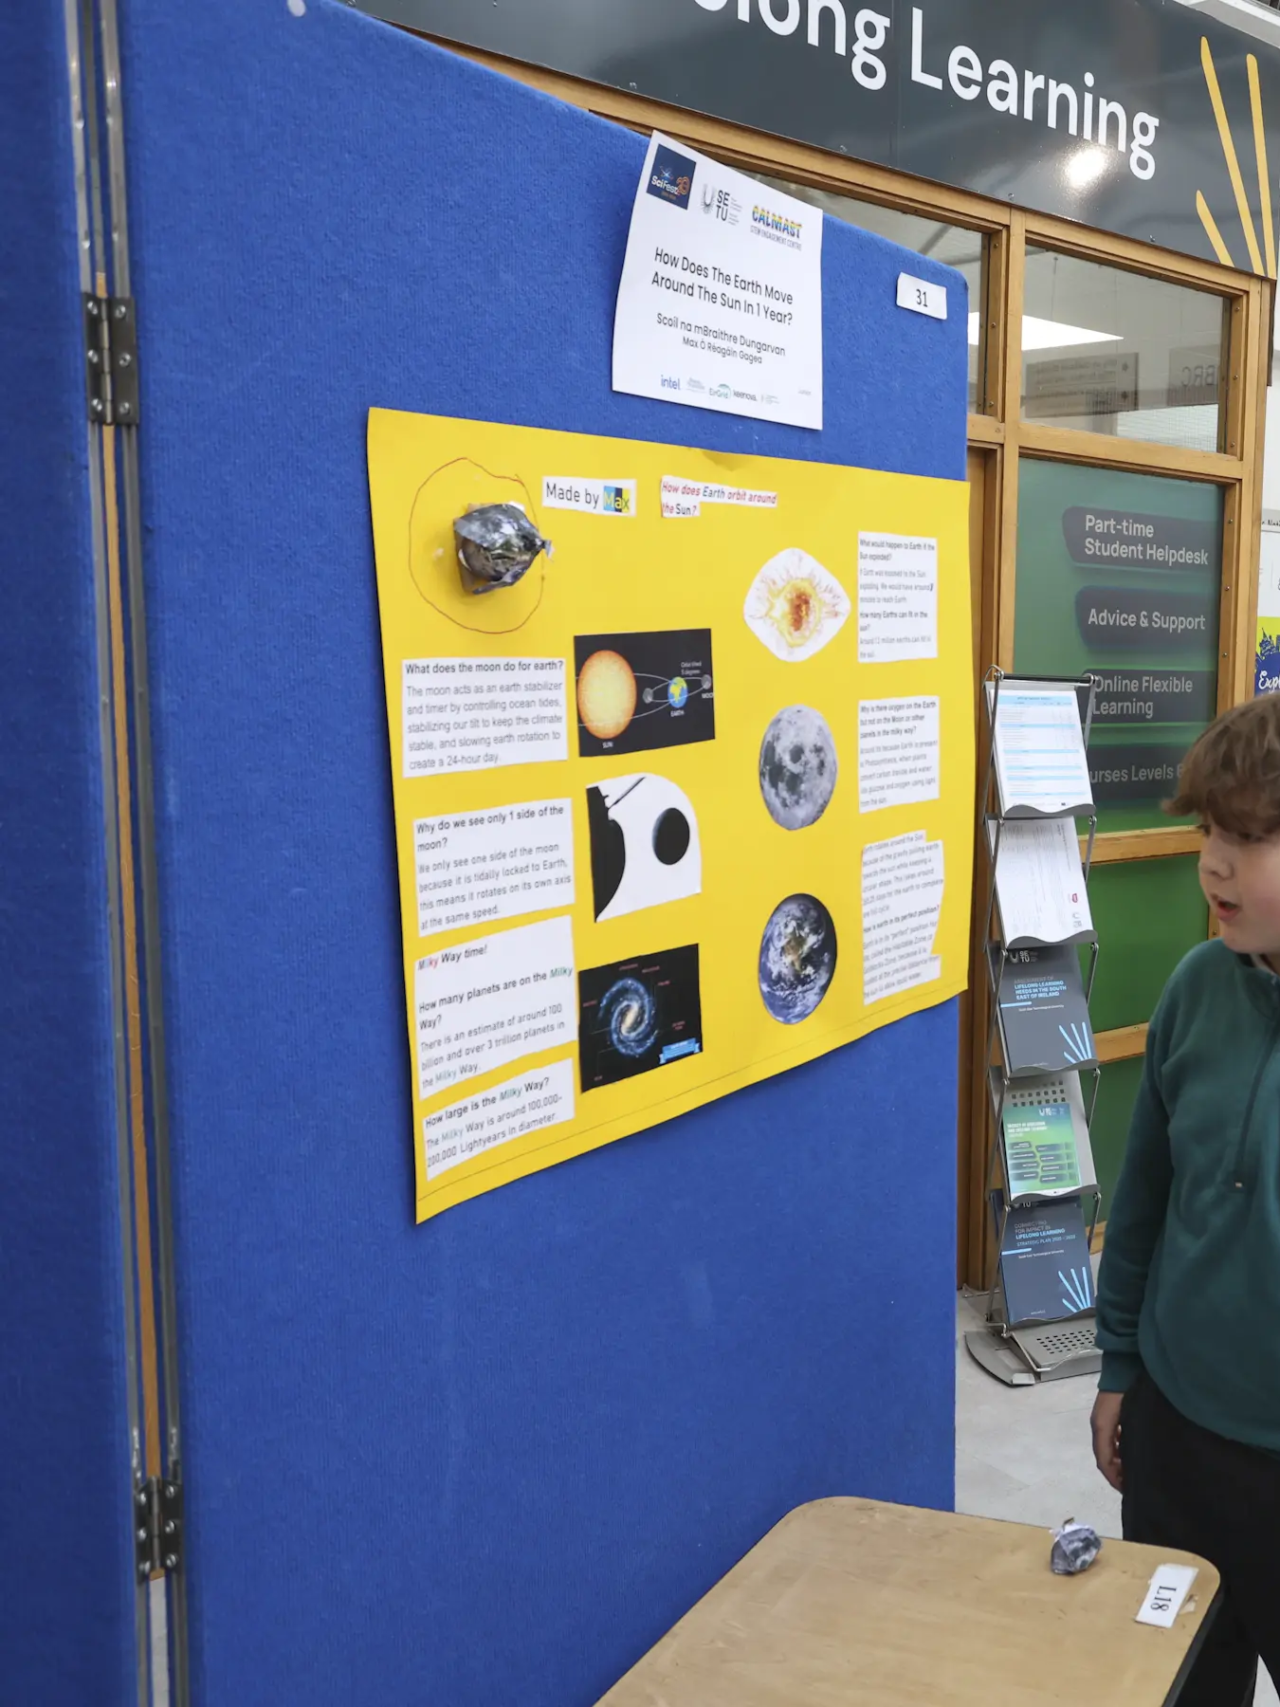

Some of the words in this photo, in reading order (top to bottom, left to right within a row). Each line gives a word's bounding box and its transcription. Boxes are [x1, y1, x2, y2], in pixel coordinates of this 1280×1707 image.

[695, 0, 890, 90] ong
[911, 7, 1159, 180] Learning
[717, 190, 730, 206] SE
[716, 205, 728, 221] TU
[752, 206, 802, 238] CALMAST
[655, 247, 679, 268] How
[682, 257, 709, 278] Does
[712, 267, 731, 285] The
[734, 275, 762, 296] Earth
[765, 285, 793, 305] Move
[652, 272, 694, 296] Around
[698, 285, 717, 303] The
[721, 293, 741, 311] Sun
[744, 300, 754, 314] In
[757, 303, 760, 316] 1
[763, 305, 792, 325] Year?
[916, 289, 928, 307] 31
[657, 313, 678, 328] Scoil
[680, 321, 692, 332] na
[694, 325, 738, 344] mBraithre
[739, 335, 785, 356] Dungarvan
[661, 375, 680, 390] intel
[546, 482, 580, 503] Made
[585, 489, 599, 509] by
[603, 487, 630, 512] Max
[662, 482, 678, 493] How
[682, 484, 700, 496] does
[703, 487, 725, 499] Earth
[727, 491, 746, 501] orbit
[748, 493, 777, 505] around
[662, 503, 674, 514] the
[676, 503, 697, 515] Sun?
[1085, 515, 1154, 538] Part-time
[1084, 538, 1143, 560] Student
[1147, 545, 1208, 565] Helpdesk
[1088, 609, 1136, 626] Advice
[1140, 611, 1149, 627] &
[1152, 611, 1205, 633] Support
[405, 664, 430, 674] What
[433, 664, 455, 674] does
[459, 663, 472, 672] the
[475, 663, 500, 672] moon
[504, 661, 515, 671] do
[518, 661, 531, 671] for
[534, 660, 563, 671] earth?
[408, 686, 422, 697] The
[426, 687, 450, 696] moon
[454, 685, 471, 694] acts
[474, 685, 484, 694] as
[487, 685, 497, 693] an
[500, 682, 521, 692] earth
[524, 681, 562, 692] stabilizer
[1095, 676, 1139, 692] Online
[1142, 676, 1193, 692] Flexible
[407, 704, 423, 715] and
[426, 703, 447, 714] timer
[450, 702, 460, 714] by
[464, 699, 506, 712] controlling
[509, 699, 536, 708] ocean
[539, 698, 561, 708] tides,
[1093, 698, 1153, 719] Learning
[408, 719, 450, 733] stabilizing
[454, 720, 467, 729] our
[470, 717, 479, 728] tilt
[482, 717, 490, 727] to
[493, 717, 513, 728] keep
[516, 715, 529, 725] the
[532, 714, 562, 725] climate
[409, 740, 436, 751] stable,
[439, 738, 456, 749] and
[459, 734, 491, 748] slowing
[494, 732, 515, 745] earth
[518, 731, 549, 743] rotation
[552, 731, 560, 740] to
[409, 757, 435, 770] create
[447, 753, 481, 766] 24-hour
[1089, 769, 1128, 783] urses
[1131, 764, 1173, 781] Levels
[417, 822, 435, 834] Why
[438, 820, 450, 831] do
[454, 819, 465, 828] we
[469, 817, 484, 826] see
[487, 812, 506, 824] only
[510, 811, 513, 820] 1
[517, 808, 535, 819] side
[538, 806, 548, 816] of
[550, 805, 563, 815] the
[418, 837, 447, 852] moon?
[442, 953, 461, 964] Way
[419, 1001, 436, 1014] How
[439, 994, 464, 1006] many
[467, 983, 500, 1000] planets
[503, 980, 516, 990] are
[520, 976, 531, 986] on
[533, 972, 547, 983] the
[550, 967, 573, 978] Milky
[420, 1015, 442, 1030] Way?
[426, 1116, 443, 1129] How
[445, 1105, 468, 1119] large
[471, 1102, 479, 1112] is
[482, 1096, 497, 1107] the
[500, 1087, 522, 1101] Milky
[525, 1077, 549, 1092] Way?
[1150, 1585, 1176, 1612] L18
